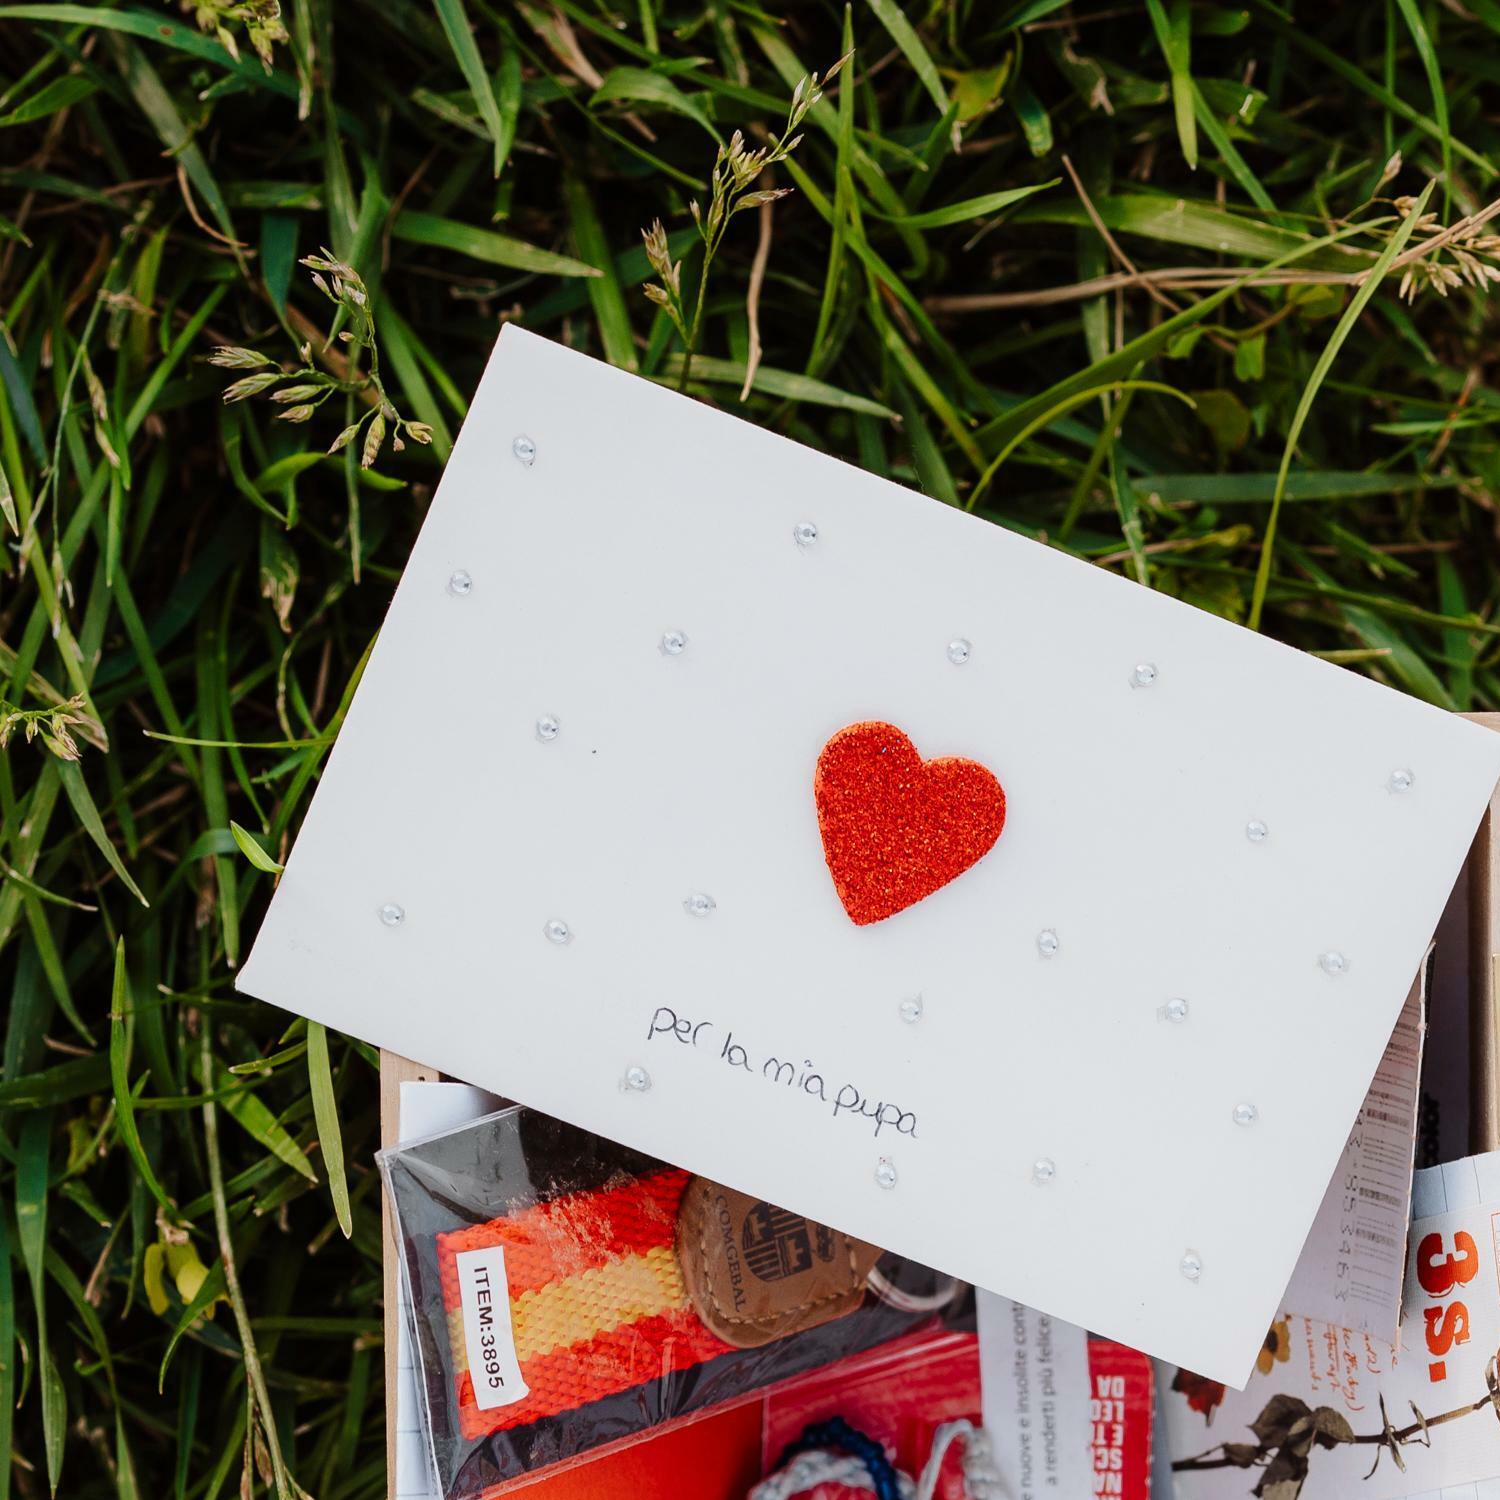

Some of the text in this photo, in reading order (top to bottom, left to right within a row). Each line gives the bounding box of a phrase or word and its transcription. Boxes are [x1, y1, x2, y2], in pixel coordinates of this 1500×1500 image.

[647, 1006, 713, 1045] per
[721, 1032, 753, 1072] la
[833, 1084, 919, 1139] pupa
[714, 1195, 746, 1313] COMGEBAL
[471, 1265, 505, 1390] ITEM:3895
[1011, 1299, 1027, 1345] cont
[1012, 1350, 1030, 1413] insolite
[1019, 1434, 1033, 1487] nuove
[1040, 1401, 1057, 1471] renderti
[1045, 1476, 1057, 1487] a
